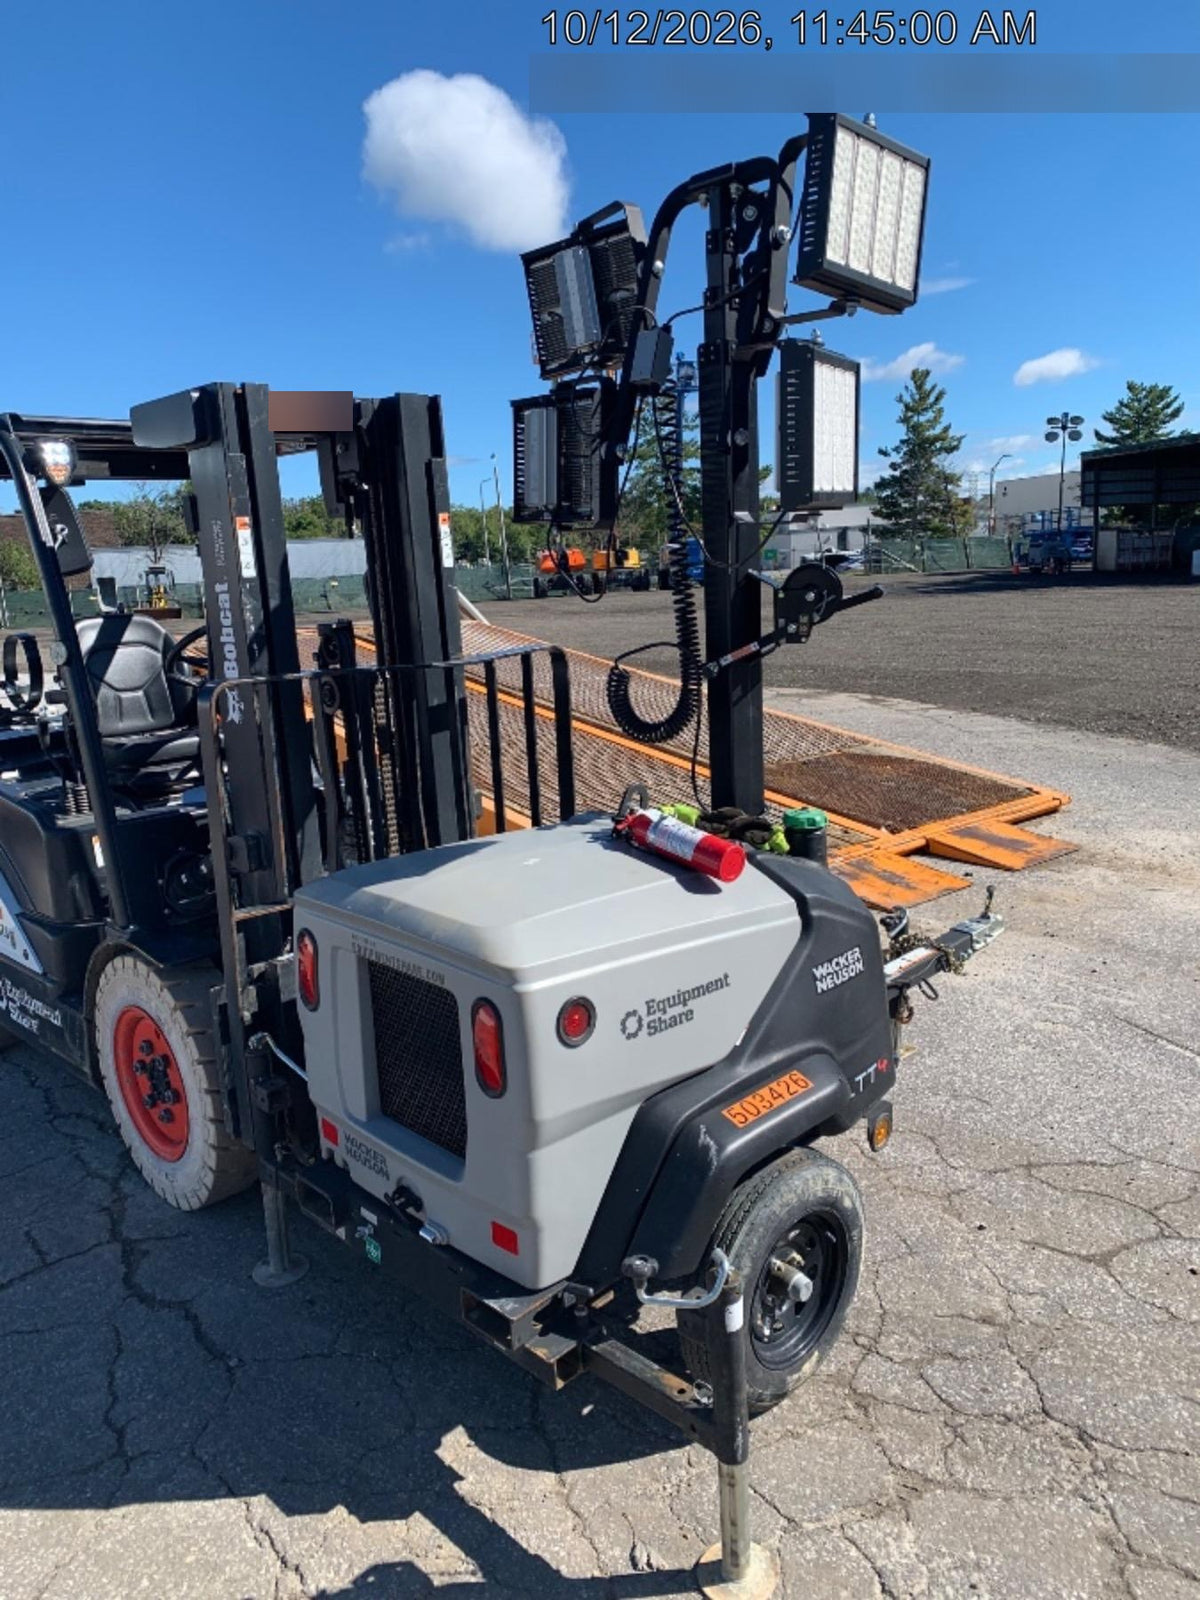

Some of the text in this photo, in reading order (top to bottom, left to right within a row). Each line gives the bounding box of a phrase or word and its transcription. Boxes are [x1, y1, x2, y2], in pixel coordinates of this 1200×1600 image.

[214, 583, 239, 678] Bobcat
[812, 946, 862, 980] WACKER
[816, 959, 864, 994] NEUSON
[645, 972, 730, 1017] Equipment
[646, 1008, 694, 1037] Share
[727, 1071, 811, 1126] 503426
